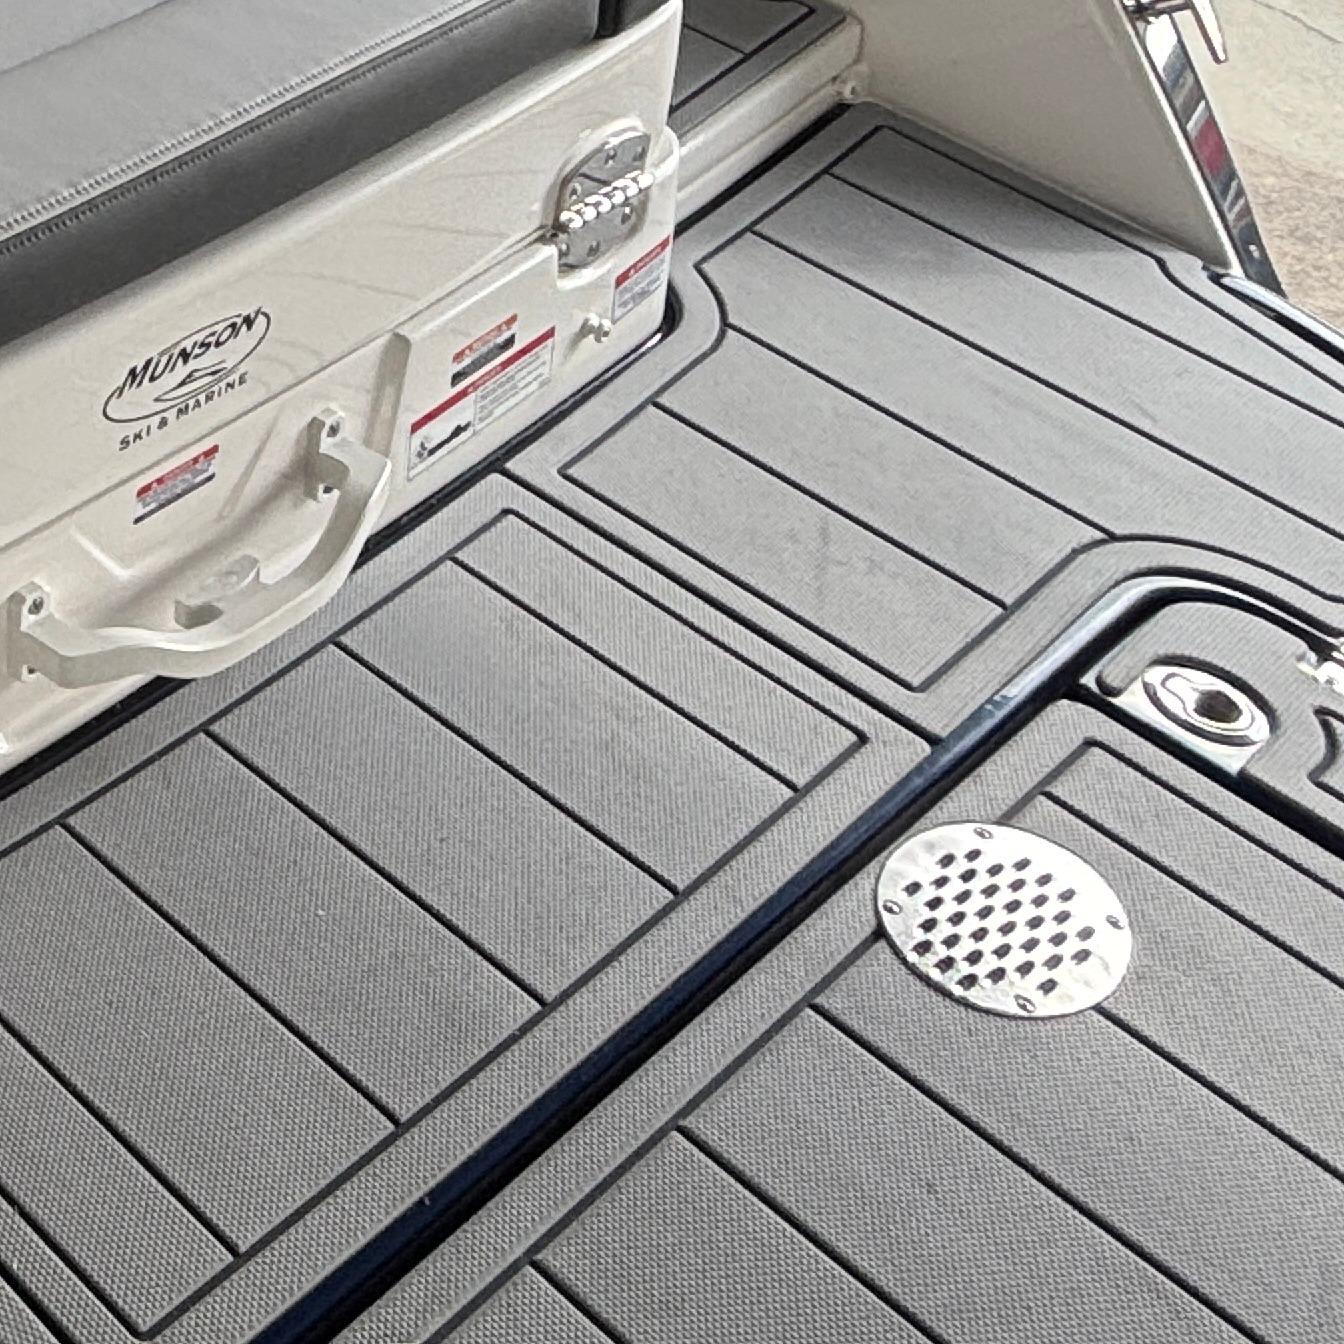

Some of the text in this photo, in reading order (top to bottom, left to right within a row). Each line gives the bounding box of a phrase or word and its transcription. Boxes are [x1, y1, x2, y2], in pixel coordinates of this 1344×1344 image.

[116, 306, 263, 399] MUNSON
[119, 424, 152, 451] SKI
[176, 371, 249, 420] MARINE
